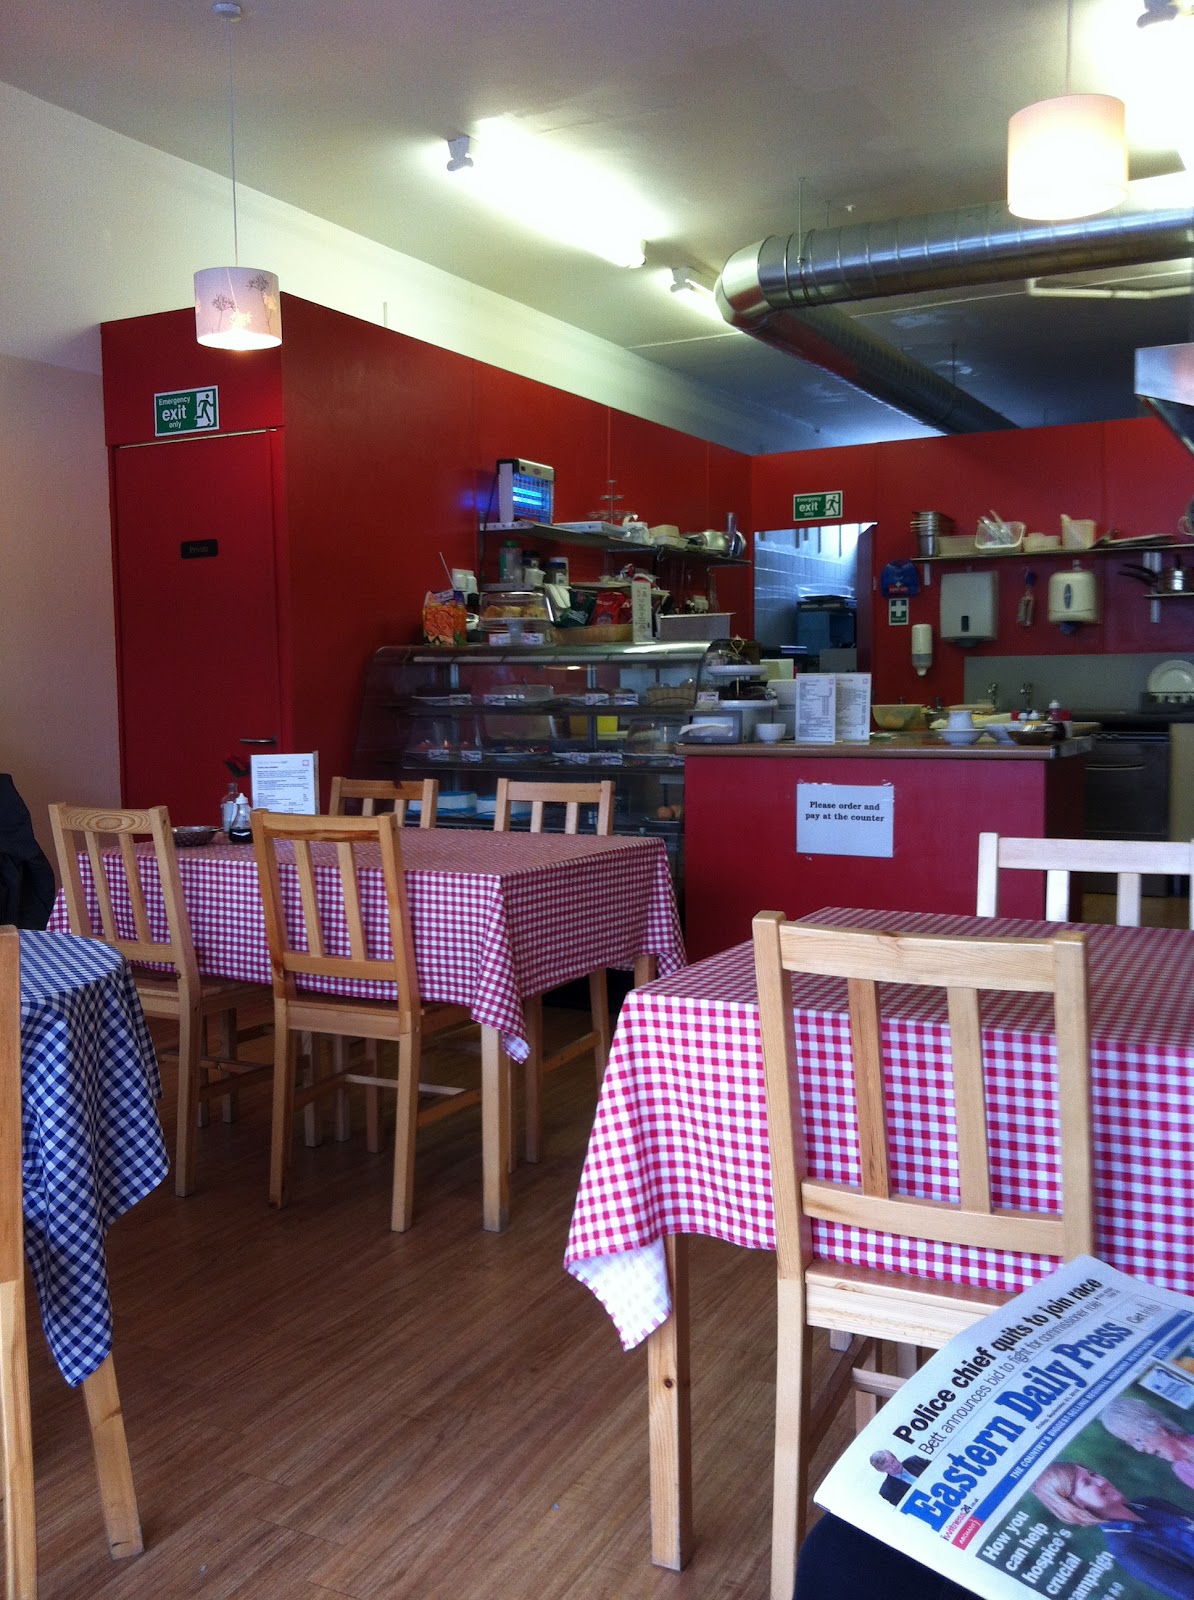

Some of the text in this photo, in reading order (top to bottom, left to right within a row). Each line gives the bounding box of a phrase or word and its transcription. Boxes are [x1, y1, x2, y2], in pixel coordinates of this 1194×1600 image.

[158, 396, 190, 405] Emergency
[162, 405, 187, 421] exit
[169, 421, 181, 429] only
[799, 502, 818, 512] exit
[809, 801, 836, 809] Please
[838, 802, 862, 810] order
[1039, 1309, 1089, 1342] commissioner
[1007, 1347, 1034, 1363] fight
[1025, 1339, 1043, 1349] for
[892, 1389, 956, 1445] Police
[951, 1346, 997, 1388] chief
[991, 1324, 1034, 1352] quits
[1022, 1314, 1050, 1327] to
[1037, 1296, 1077, 1319] join
[1067, 1278, 1103, 1301] race
[1000, 1362, 1015, 1373] to
[983, 1369, 1006, 1386] bid
[941, 1385, 992, 1434] announces
[900, 1322, 1133, 1533] Eastern Daily Press
[918, 1431, 947, 1455] Bett
[1010, 1465, 1026, 1479] THE
[1020, 1434, 1051, 1468] COUNTRY'S
[982, 1510, 1030, 1561] How you
[1005, 1522, 1049, 1572] can help
[1021, 1528, 1073, 1584] hospice's
[1046, 1552, 1083, 1595] crucial
